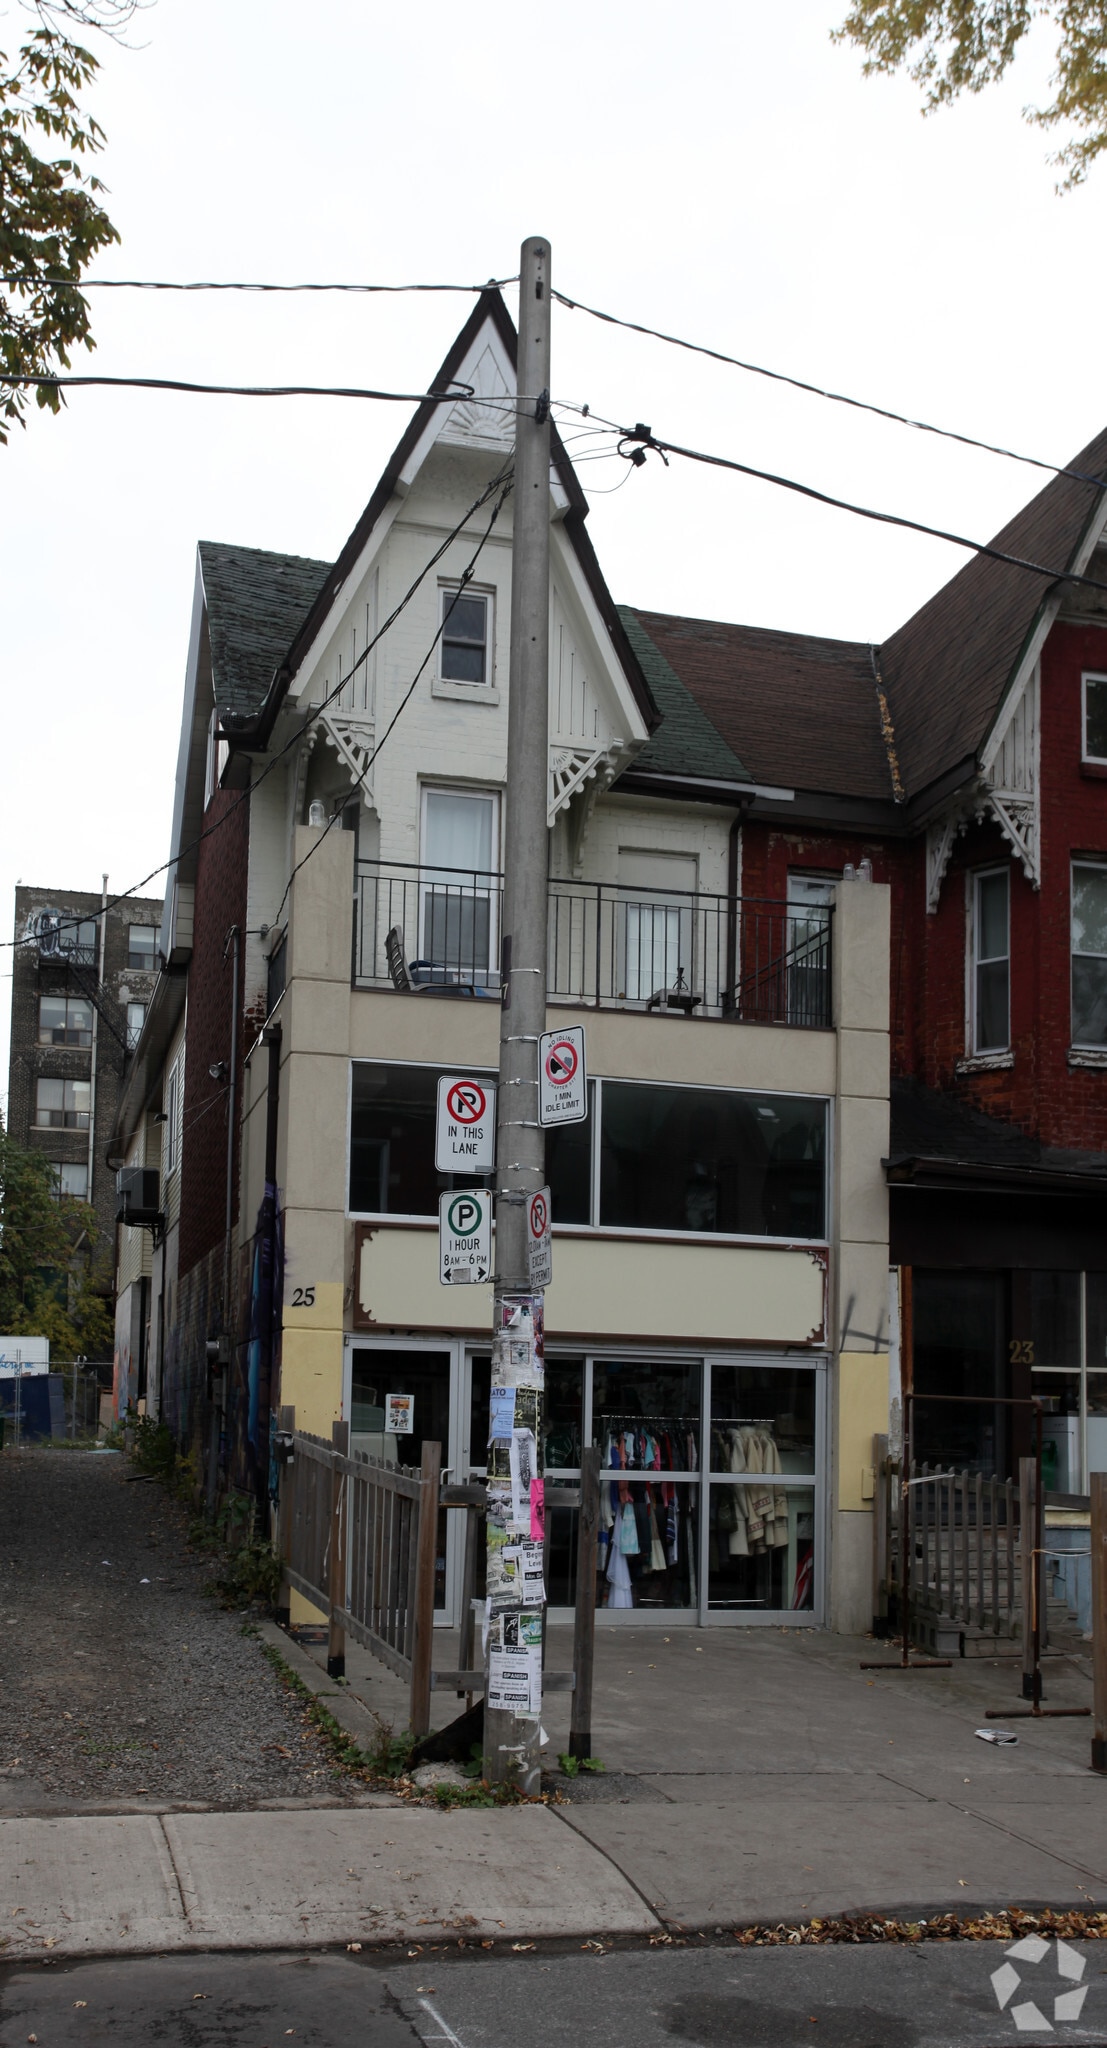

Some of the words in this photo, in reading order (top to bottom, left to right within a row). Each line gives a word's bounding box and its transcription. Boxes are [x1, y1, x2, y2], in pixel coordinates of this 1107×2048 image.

[556, 1035, 575, 1044] IDLING
[559, 1091, 572, 1100] MIN
[545, 1103, 561, 1112] IDLE
[562, 1100, 580, 1109] LIMIT
[448, 1125, 457, 1137] IN
[462, 1126, 484, 1140] THIS
[452, 1142, 479, 1155] LANE
[458, 1204, 474, 1227] P
[449, 1240, 453, 1251] 1
[455, 1238, 480, 1251] HOUR
[291, 1287, 315, 1307] 25
[1009, 1340, 1035, 1364] 23
